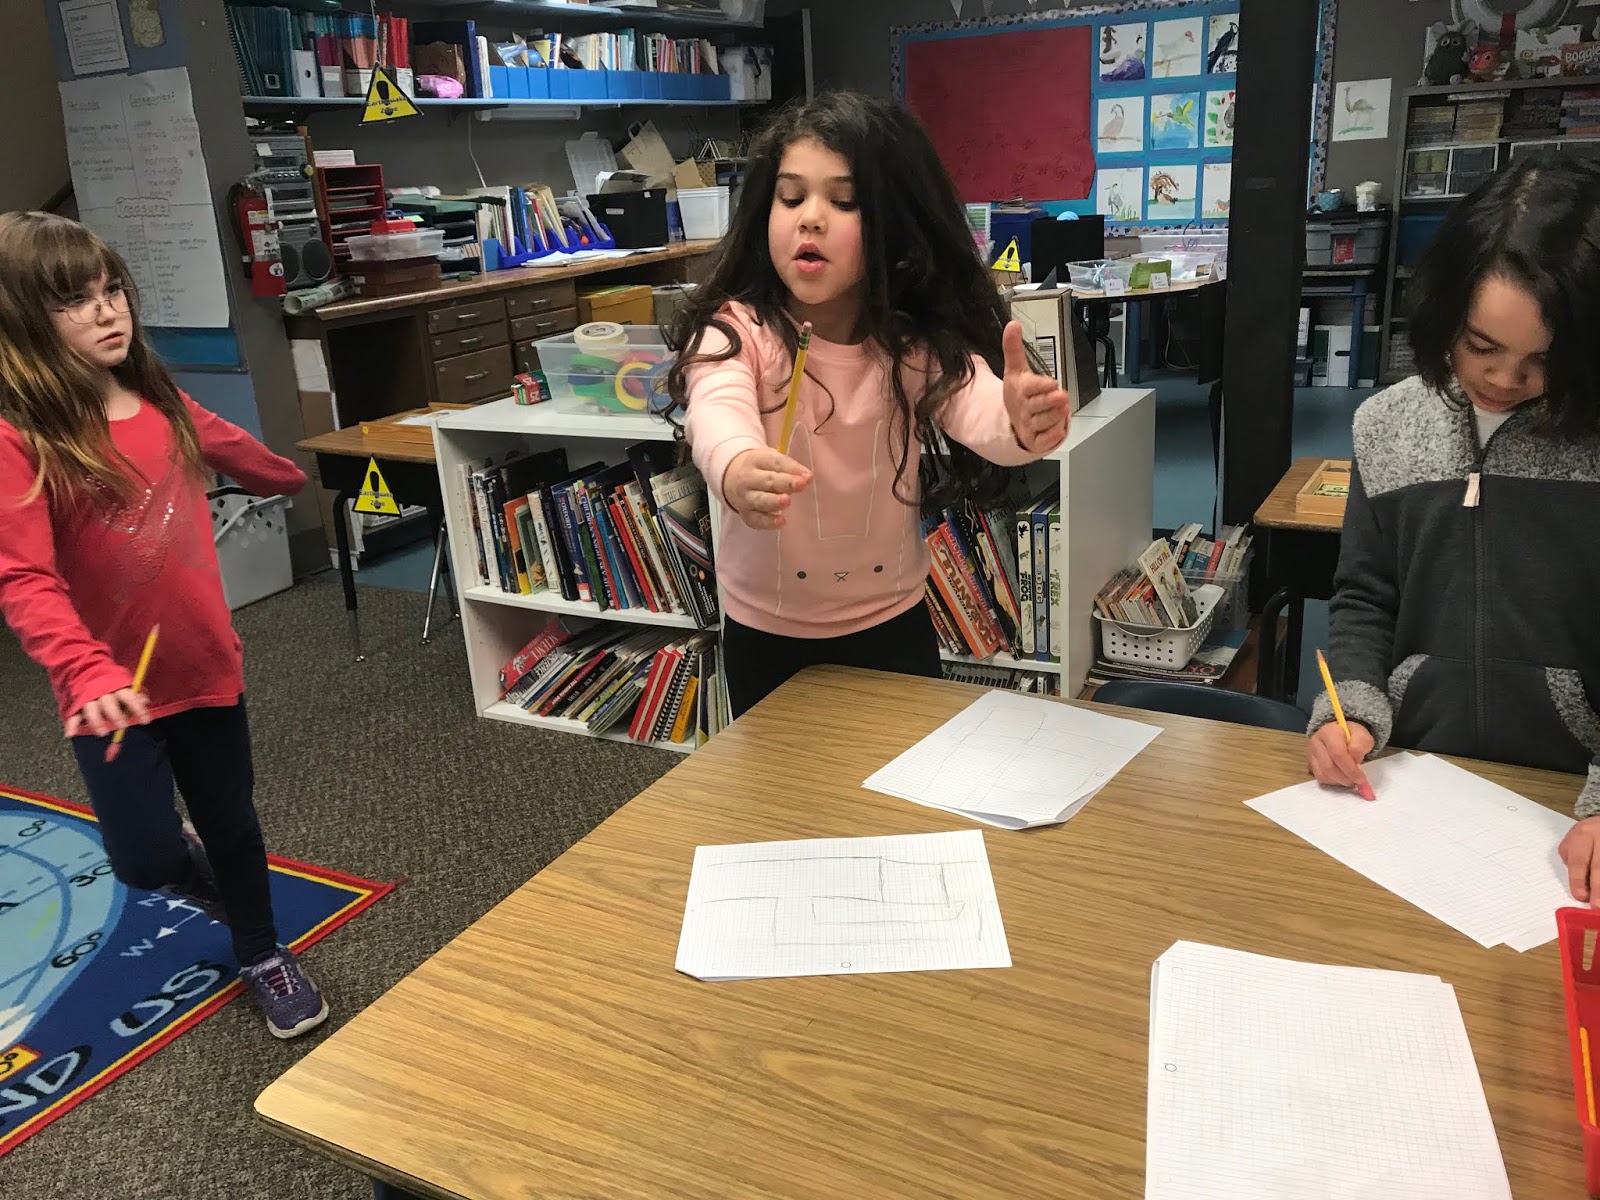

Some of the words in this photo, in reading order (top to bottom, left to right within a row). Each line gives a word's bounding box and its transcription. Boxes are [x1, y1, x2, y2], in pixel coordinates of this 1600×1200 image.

[116, 200, 167, 213] Treasure
[561, 502, 572, 529] OXFORD
[1020, 571, 1029, 602] FROG
[1035, 574, 1044, 603] DOG
[1050, 573, 1060, 607] T.REX
[529, 634, 559, 661] SCIENCE
[110, 963, 224, 1038] US
